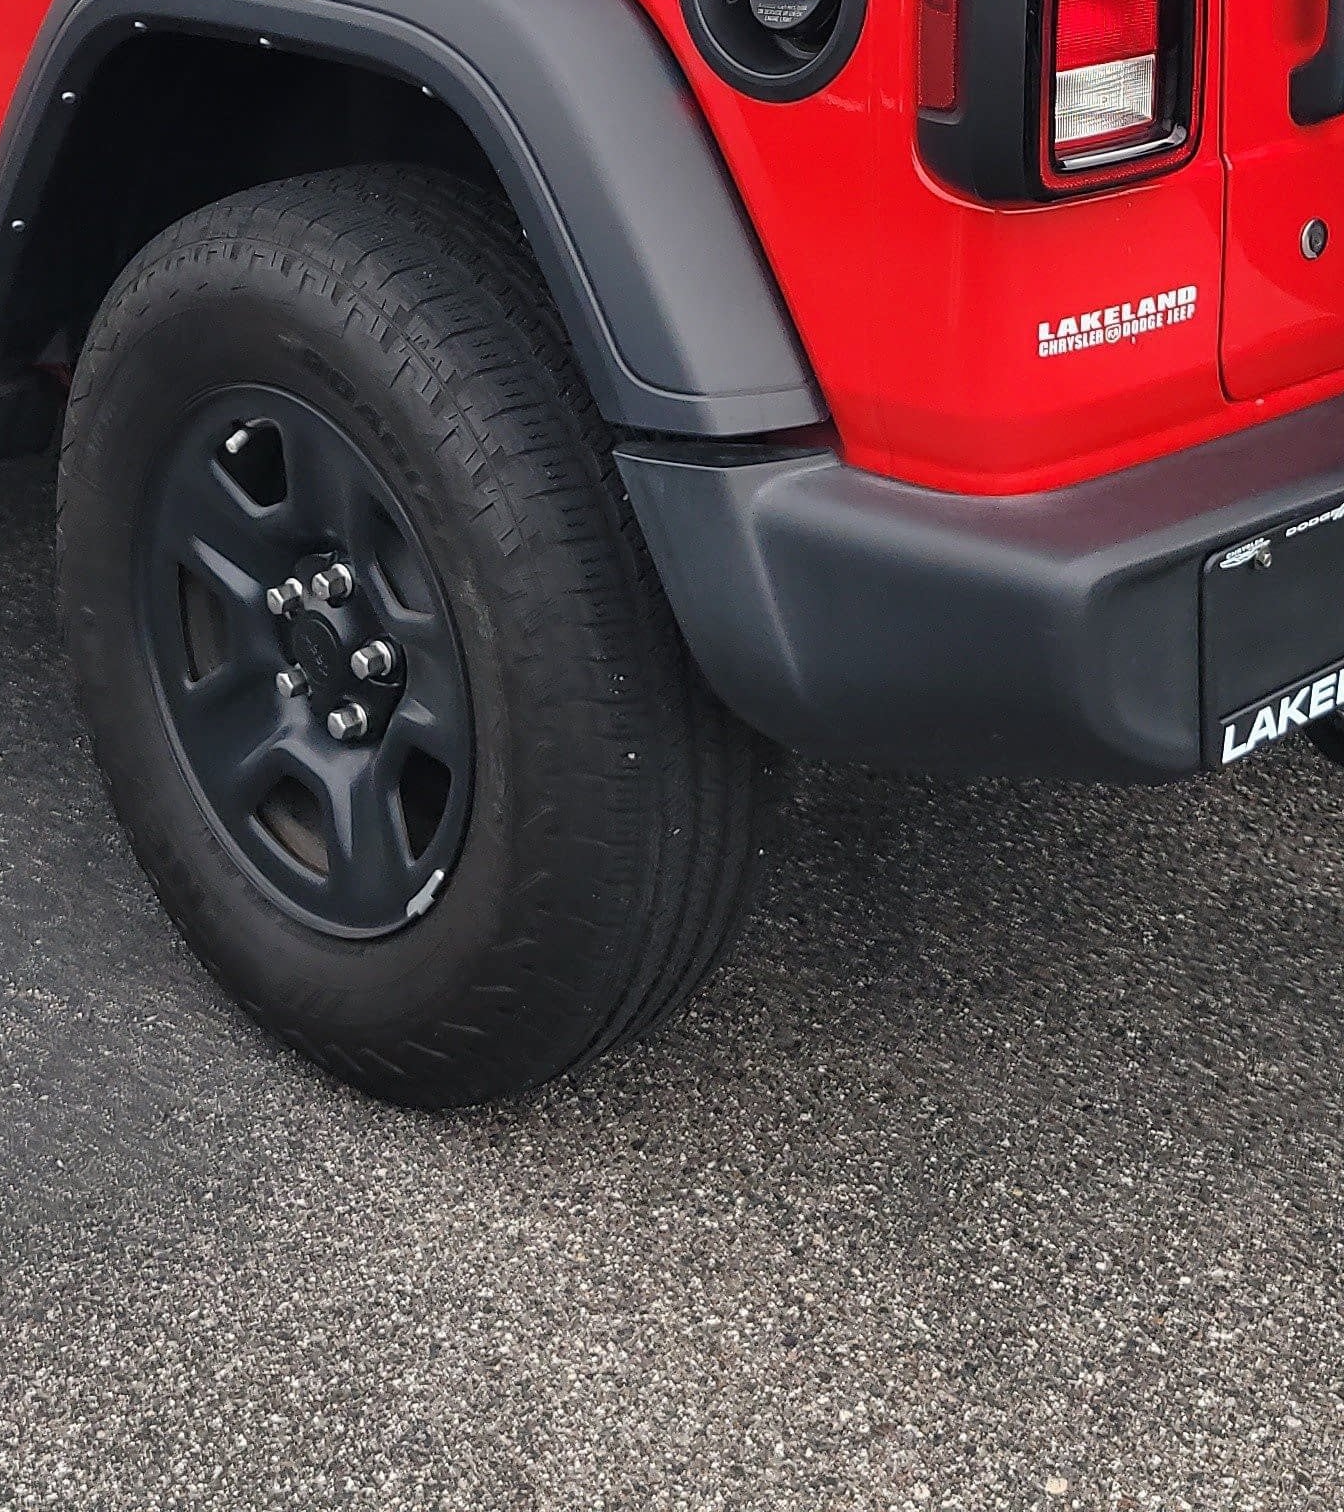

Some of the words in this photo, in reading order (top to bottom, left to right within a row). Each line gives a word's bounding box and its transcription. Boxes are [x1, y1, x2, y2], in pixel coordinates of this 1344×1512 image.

[1038, 286, 1197, 341] LAKELAND
[1038, 328, 1104, 358] CHRYSLER
[1122, 313, 1163, 338] DODGE
[1166, 303, 1195, 325] JEEP
